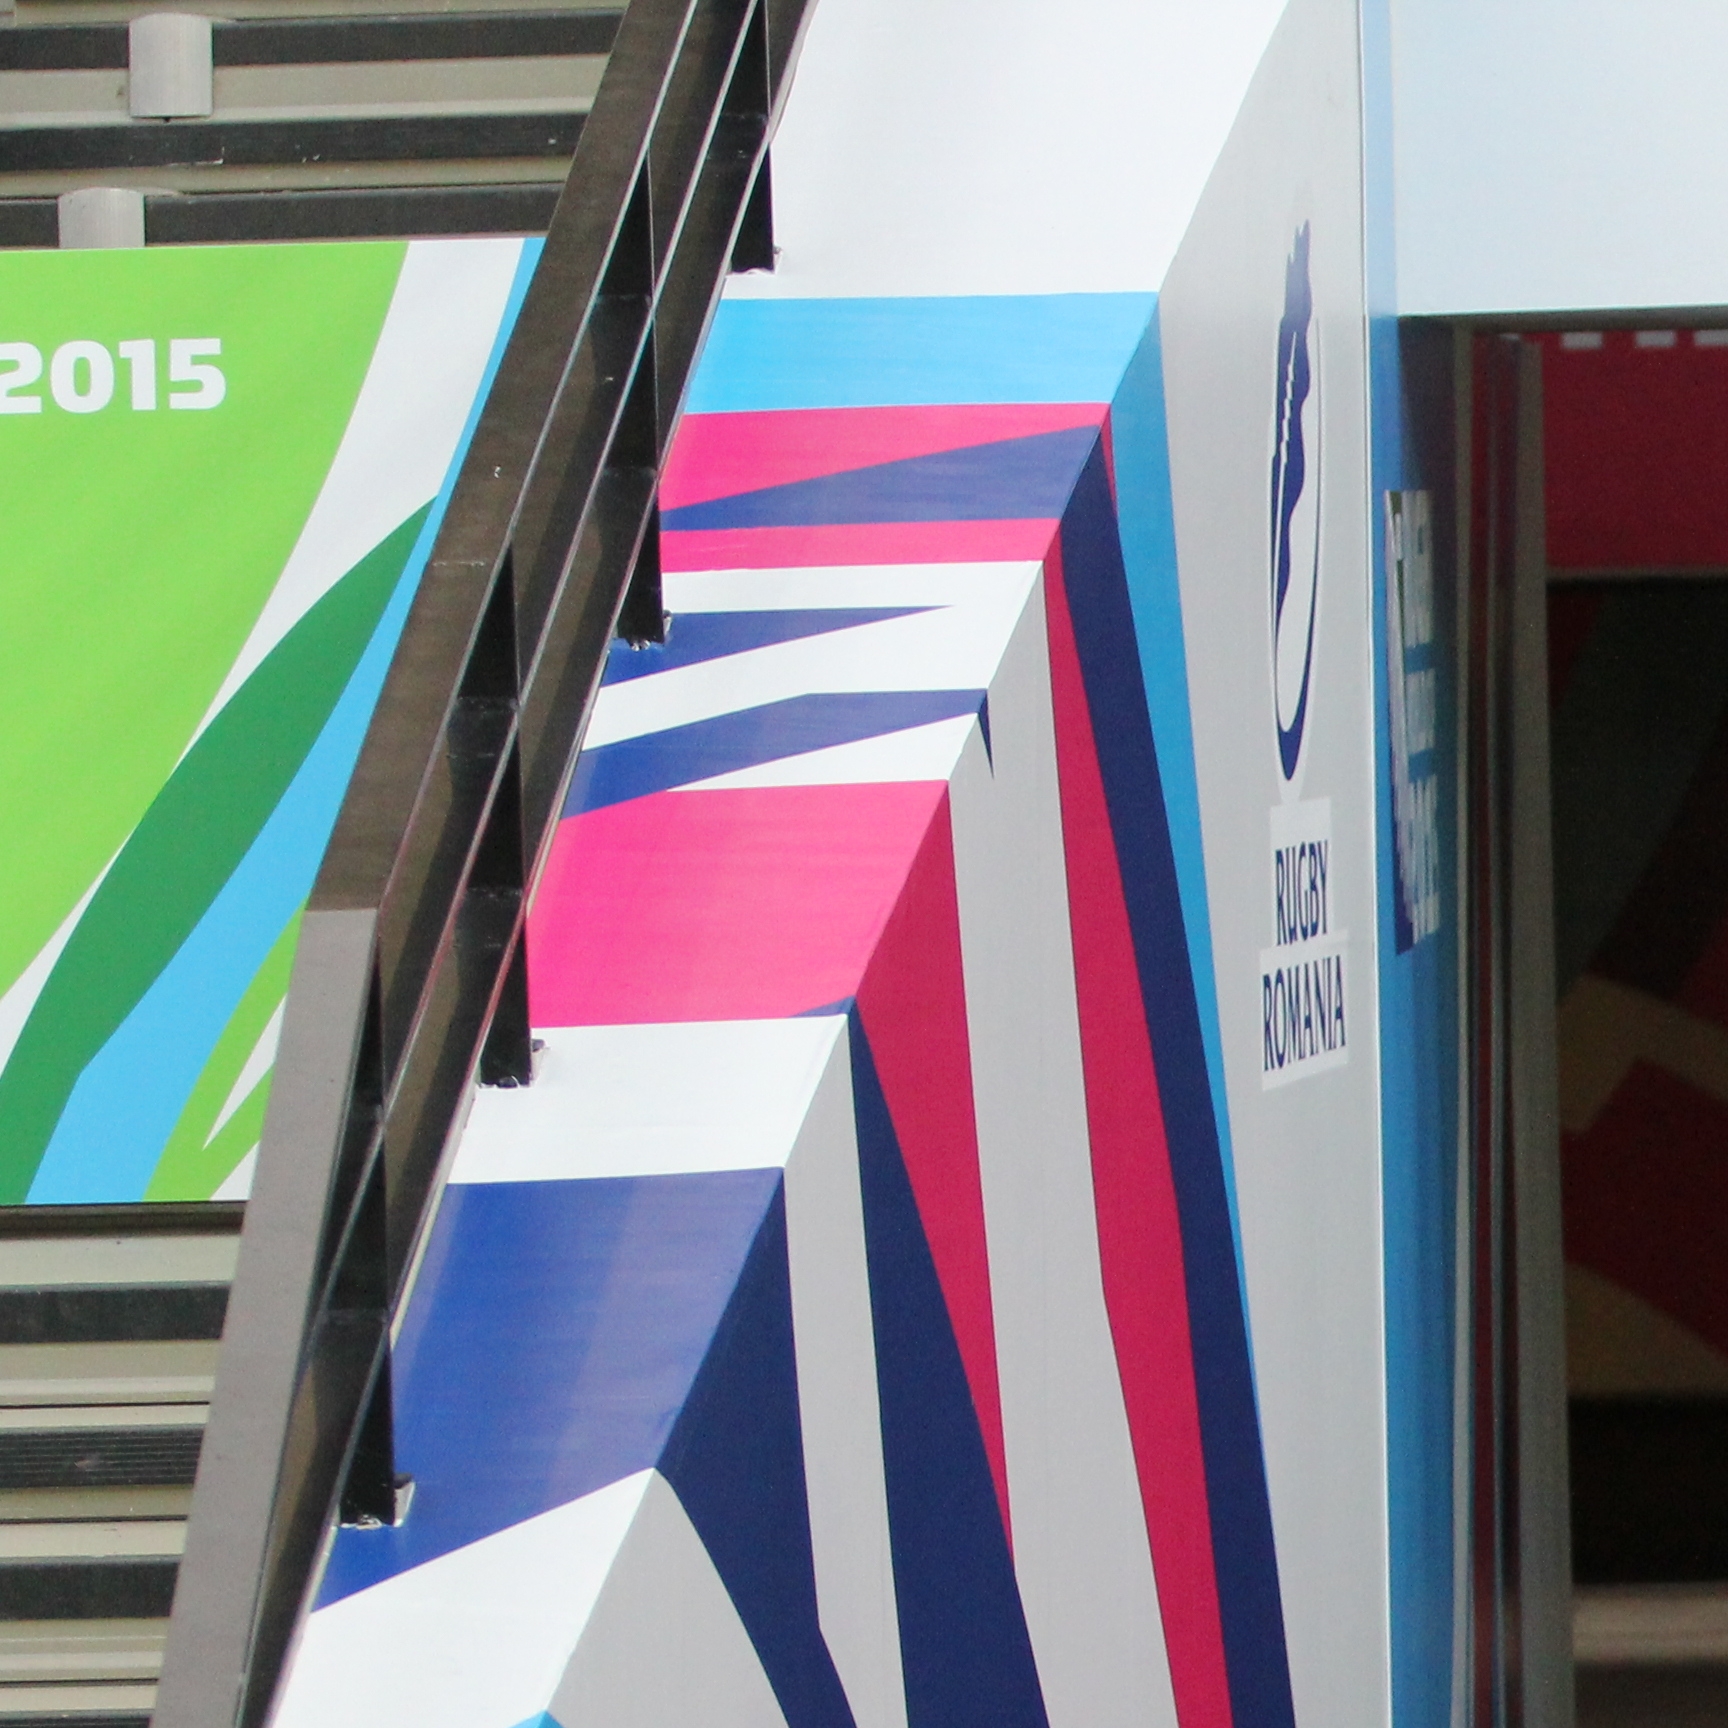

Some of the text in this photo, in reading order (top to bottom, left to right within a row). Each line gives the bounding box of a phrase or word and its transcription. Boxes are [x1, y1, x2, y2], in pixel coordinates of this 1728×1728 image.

[0, 338, 227, 414] 2015
[1275, 839, 1329, 946] RUGBY
[1263, 955, 1346, 1072] ROMANIA
